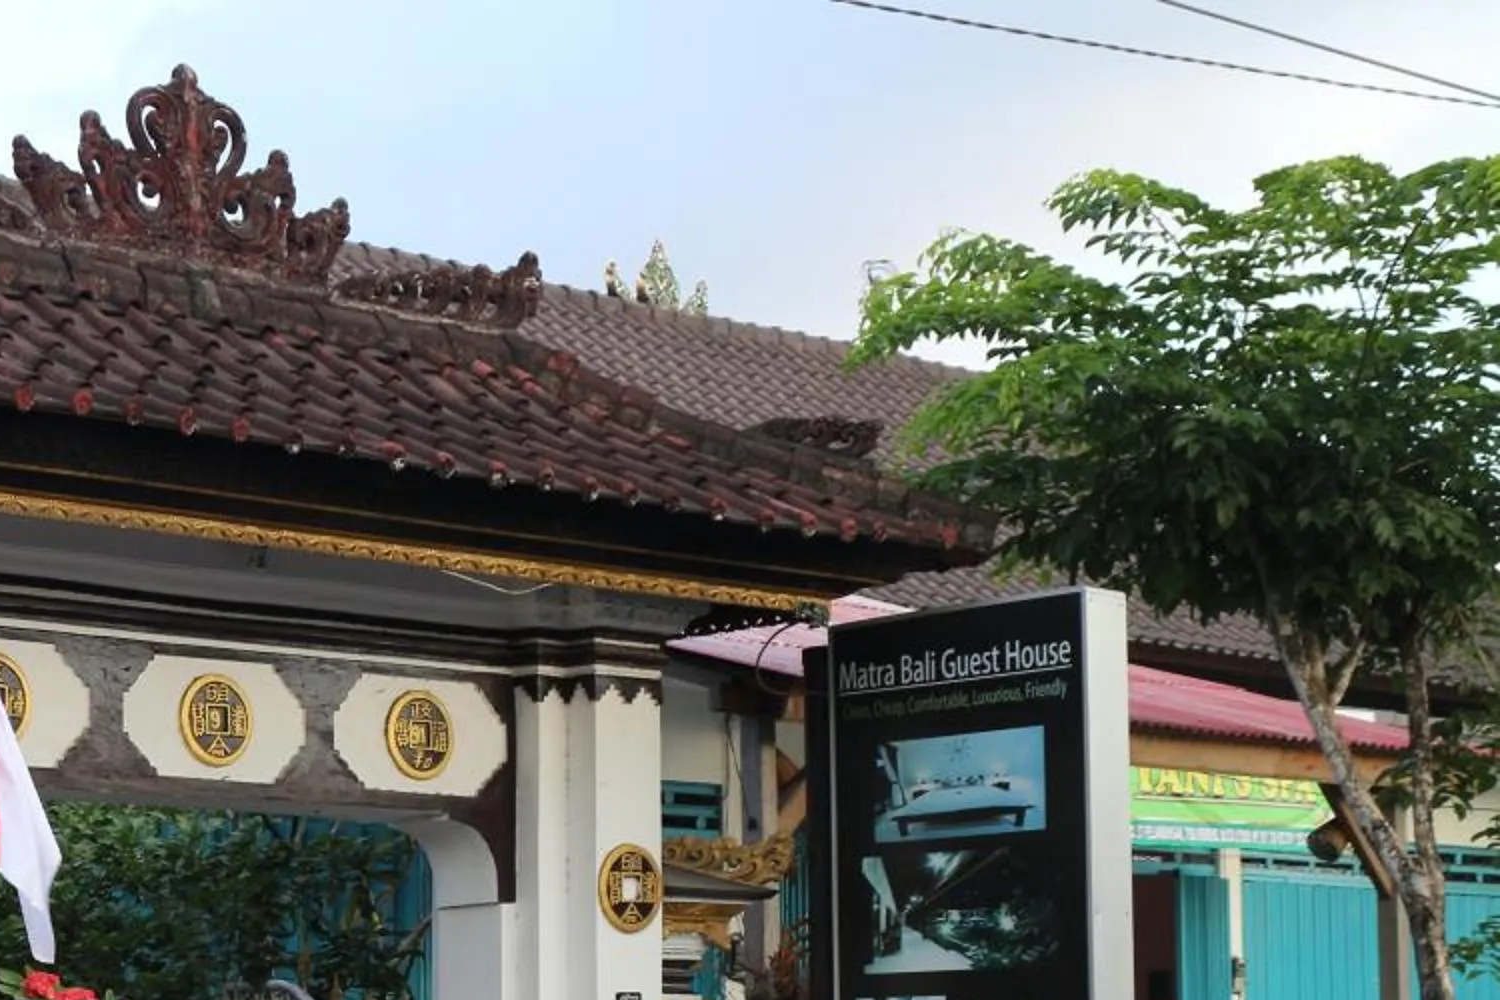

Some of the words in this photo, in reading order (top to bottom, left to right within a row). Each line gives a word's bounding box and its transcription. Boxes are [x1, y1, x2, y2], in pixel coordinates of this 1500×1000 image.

[839, 660, 896, 691] Matra
[900, 650, 937, 686] Bali
[940, 646, 1000, 680] Guest
[1004, 639, 1072, 671] House
[1025, 677, 1068, 701] Friendly
